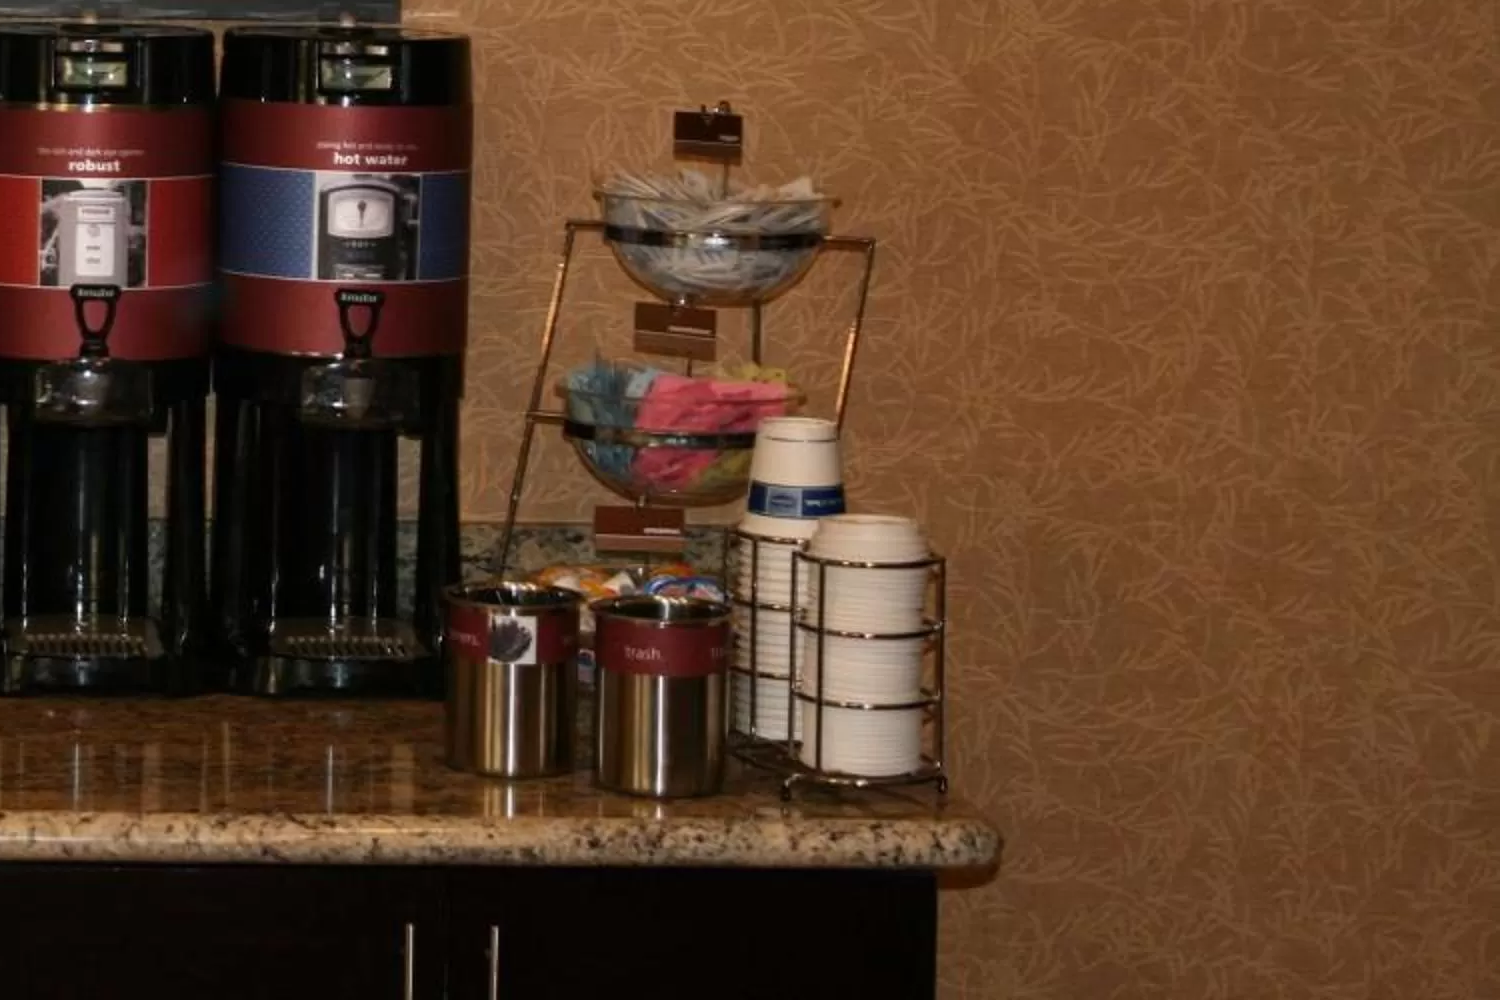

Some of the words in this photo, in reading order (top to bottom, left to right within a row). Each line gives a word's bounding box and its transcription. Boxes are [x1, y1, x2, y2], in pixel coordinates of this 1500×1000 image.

[68, 158, 121, 173] robust
[333, 151, 361, 165] hot
[365, 154, 408, 166] water
[623, 644, 661, 661] trash
